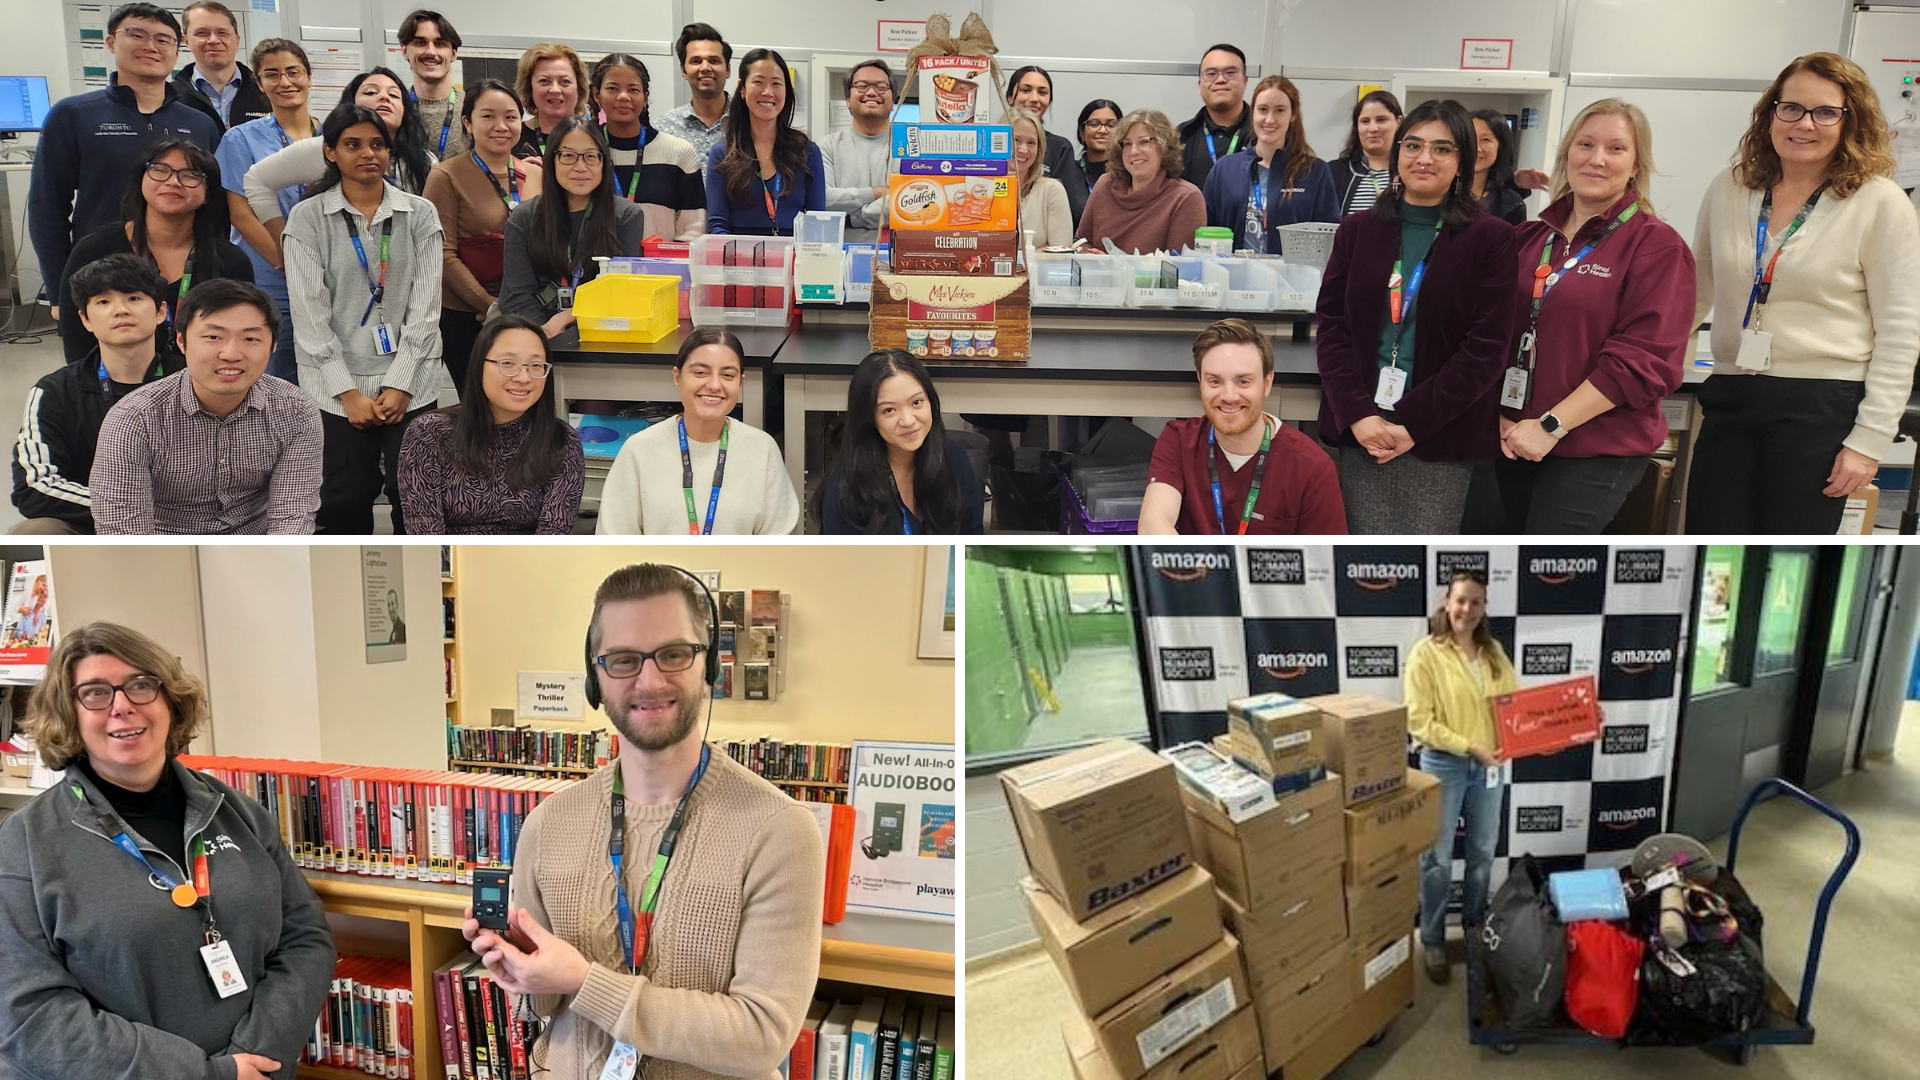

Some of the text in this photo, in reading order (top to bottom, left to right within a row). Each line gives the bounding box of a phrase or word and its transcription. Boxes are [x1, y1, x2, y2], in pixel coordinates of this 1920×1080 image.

[922, 58, 933, 68] 16
[911, 162, 933, 170] Cadbury
[901, 191, 937, 207] Goldfish
[935, 236, 978, 249] CELEBRATION
[929, 285, 975, 301] Miss Vickie's
[926, 311, 977, 320] FAVOURITES
[1152, 553, 1230, 569] amazon
[1251, 552, 1300, 560] TORONTO
[1347, 563, 1418, 579] amazon
[1530, 557, 1597, 573] amazon
[1251, 572, 1302, 581] SOCIETY
[1617, 571, 1659, 580] SOCIETY
[1349, 649, 1395, 657] TORONTO
[1526, 647, 1568, 655] TORONTO
[1612, 648, 1671, 664] amazon
[1258, 653, 1328, 667] amazon
[1165, 669, 1211, 678] SOCIETY
[1349, 667, 1395, 675] SOCIETY
[1526, 664, 1567, 673] SOCIETY
[1606, 743, 1645, 752] SOCIETY
[873, 753, 911, 766] New!
[857, 773, 955, 792] AUDIOBOO
[1353, 776, 1403, 800] Baxter
[1598, 806, 1655, 823] amazon
[1088, 853, 1186, 910] Baxter
[622, 922, 631, 948] DISCOVERY
[211, 954, 229, 964] ANDREA
[883, 1042, 895, 1056] ALAN
[938, 1054, 949, 1067] TIM
